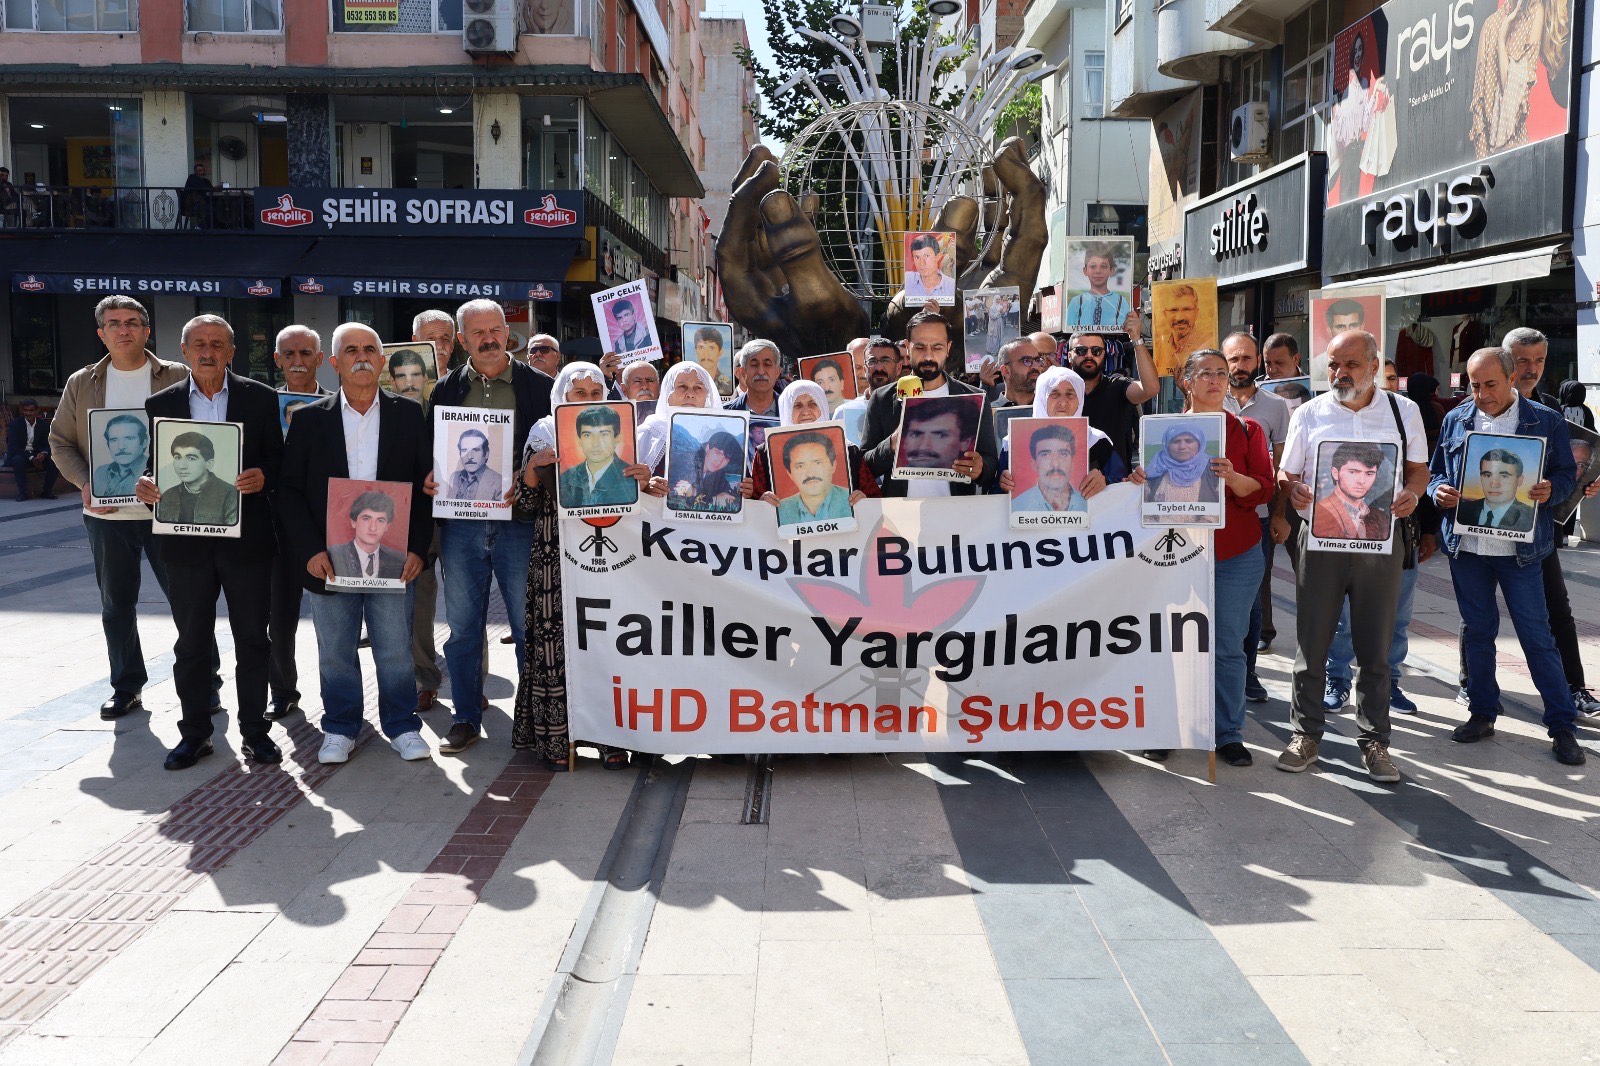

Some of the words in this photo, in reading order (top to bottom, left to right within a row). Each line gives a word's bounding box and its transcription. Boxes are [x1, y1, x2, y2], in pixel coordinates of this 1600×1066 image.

[346, 10, 363, 21] 0532
[364, 10, 377, 21] 553
[1396, 0, 1474, 80] rays
[267, 210, 307, 223] şenpiliç
[322, 191, 398, 229] ŞEHİR
[405, 199, 514, 225] SOFRASI
[530, 210, 570, 224] şenpiliç
[73, 276, 132, 292] ŞEHİR
[137, 279, 220, 293] SOFRASI
[352, 279, 411, 295] ŞEHİR
[417, 282, 500, 296] SOFRASI
[596, 292, 615, 304] EDİP
[617, 284, 642, 297] ÇELİK
[441, 410, 481, 422] İBRAHİM
[483, 412, 510, 425] ÇELİK
[898, 468, 935, 479] Hüseyin
[99, 496, 134, 505] İBRAHİM
[602, 506, 632, 515] MALTU
[1157, 503, 1187, 514] Taybet
[1189, 504, 1206, 512] Ana
[675, 510, 703, 521] İSMAİL
[1018, 515, 1039, 525] Eset
[173, 525, 201, 534] ÇETİN
[796, 525, 814, 536] İSA
[816, 521, 839, 534] GÖK
[1467, 526, 1495, 536] RESUL
[1496, 528, 1526, 540] SAÇAN
[641, 520, 858, 582] Kayıplar
[876, 529, 1135, 577] Bulunsun
[1317, 540, 1347, 549] Yılmaz
[1349, 541, 1383, 551] GÜMÜŞ
[580, 563, 609, 573] HAKLARI
[591, 557, 607, 566] 1986
[362, 579, 389, 587] KAVAK
[576, 597, 792, 662] Failler
[810, 609, 1210, 683] Yargılansın
[612, 675, 708, 733] İHD
[729, 688, 938, 735] Batman
[958, 684, 1145, 744] Şubesi
